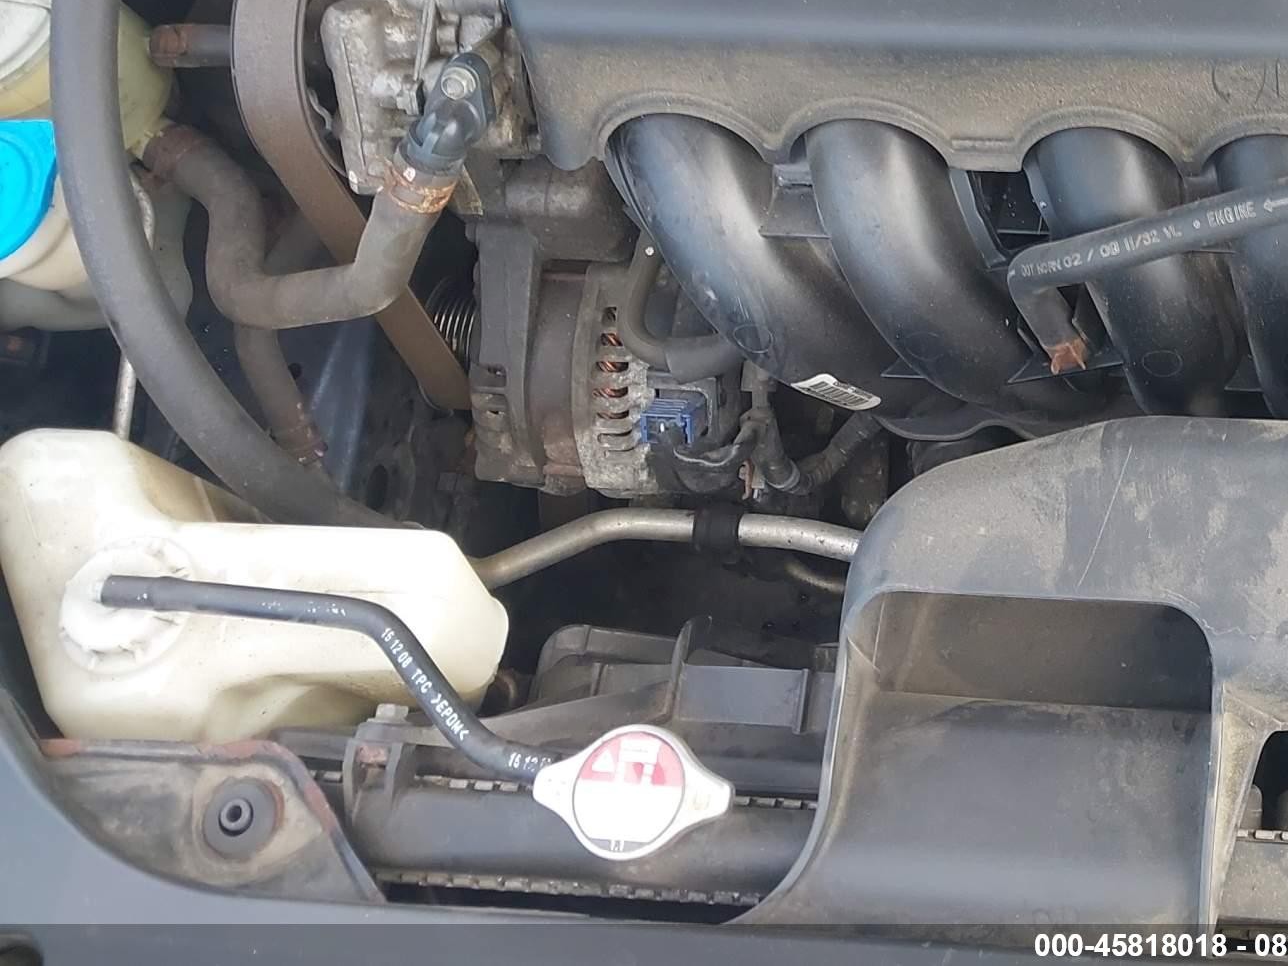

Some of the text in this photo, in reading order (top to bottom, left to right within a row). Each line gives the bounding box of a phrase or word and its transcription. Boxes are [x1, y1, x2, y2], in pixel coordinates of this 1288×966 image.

[1206, 201, 1257, 228] ENGINE
[1064, 252, 1083, 269] 02
[389, 638, 404, 656] 12
[411, 667, 433, 694] TPC
